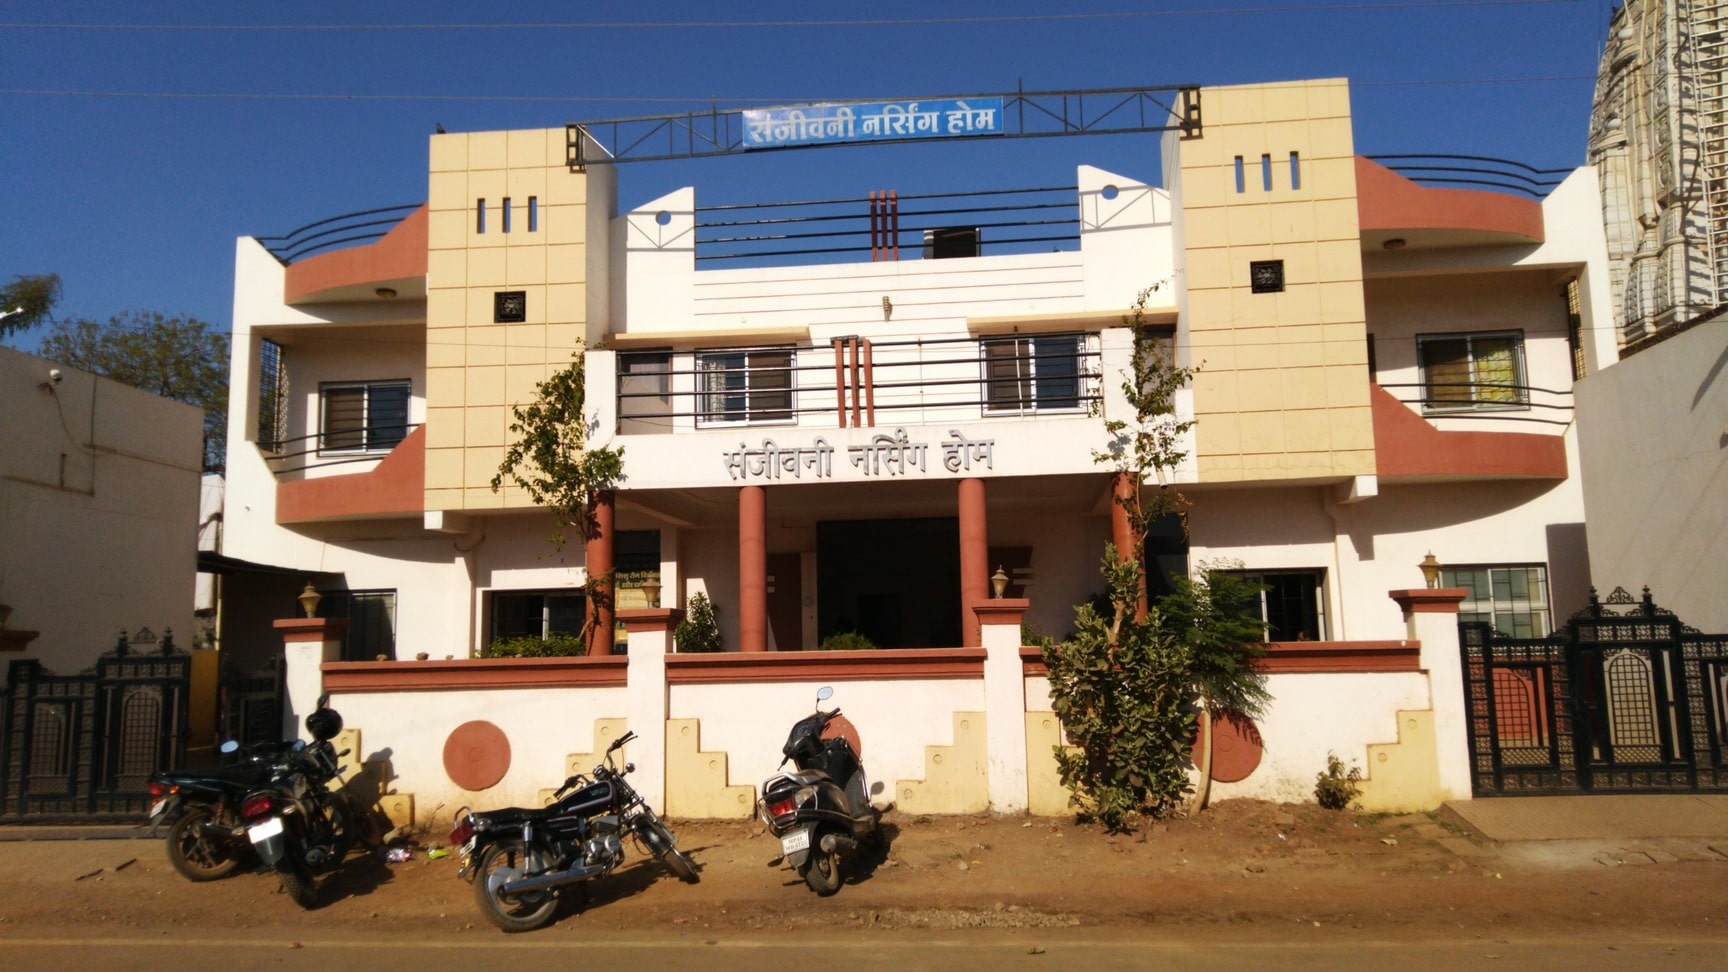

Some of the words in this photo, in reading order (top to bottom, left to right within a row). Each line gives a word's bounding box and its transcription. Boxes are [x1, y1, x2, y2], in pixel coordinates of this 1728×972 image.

[750, 107, 856, 142] संजीवनी
[861, 102, 940, 136] नर्सिंग
[946, 101, 996, 134] होम
[723, 435, 835, 481] संजीवनी
[847, 427, 929, 477] नर्सिंग
[940, 429, 995, 473] होम
